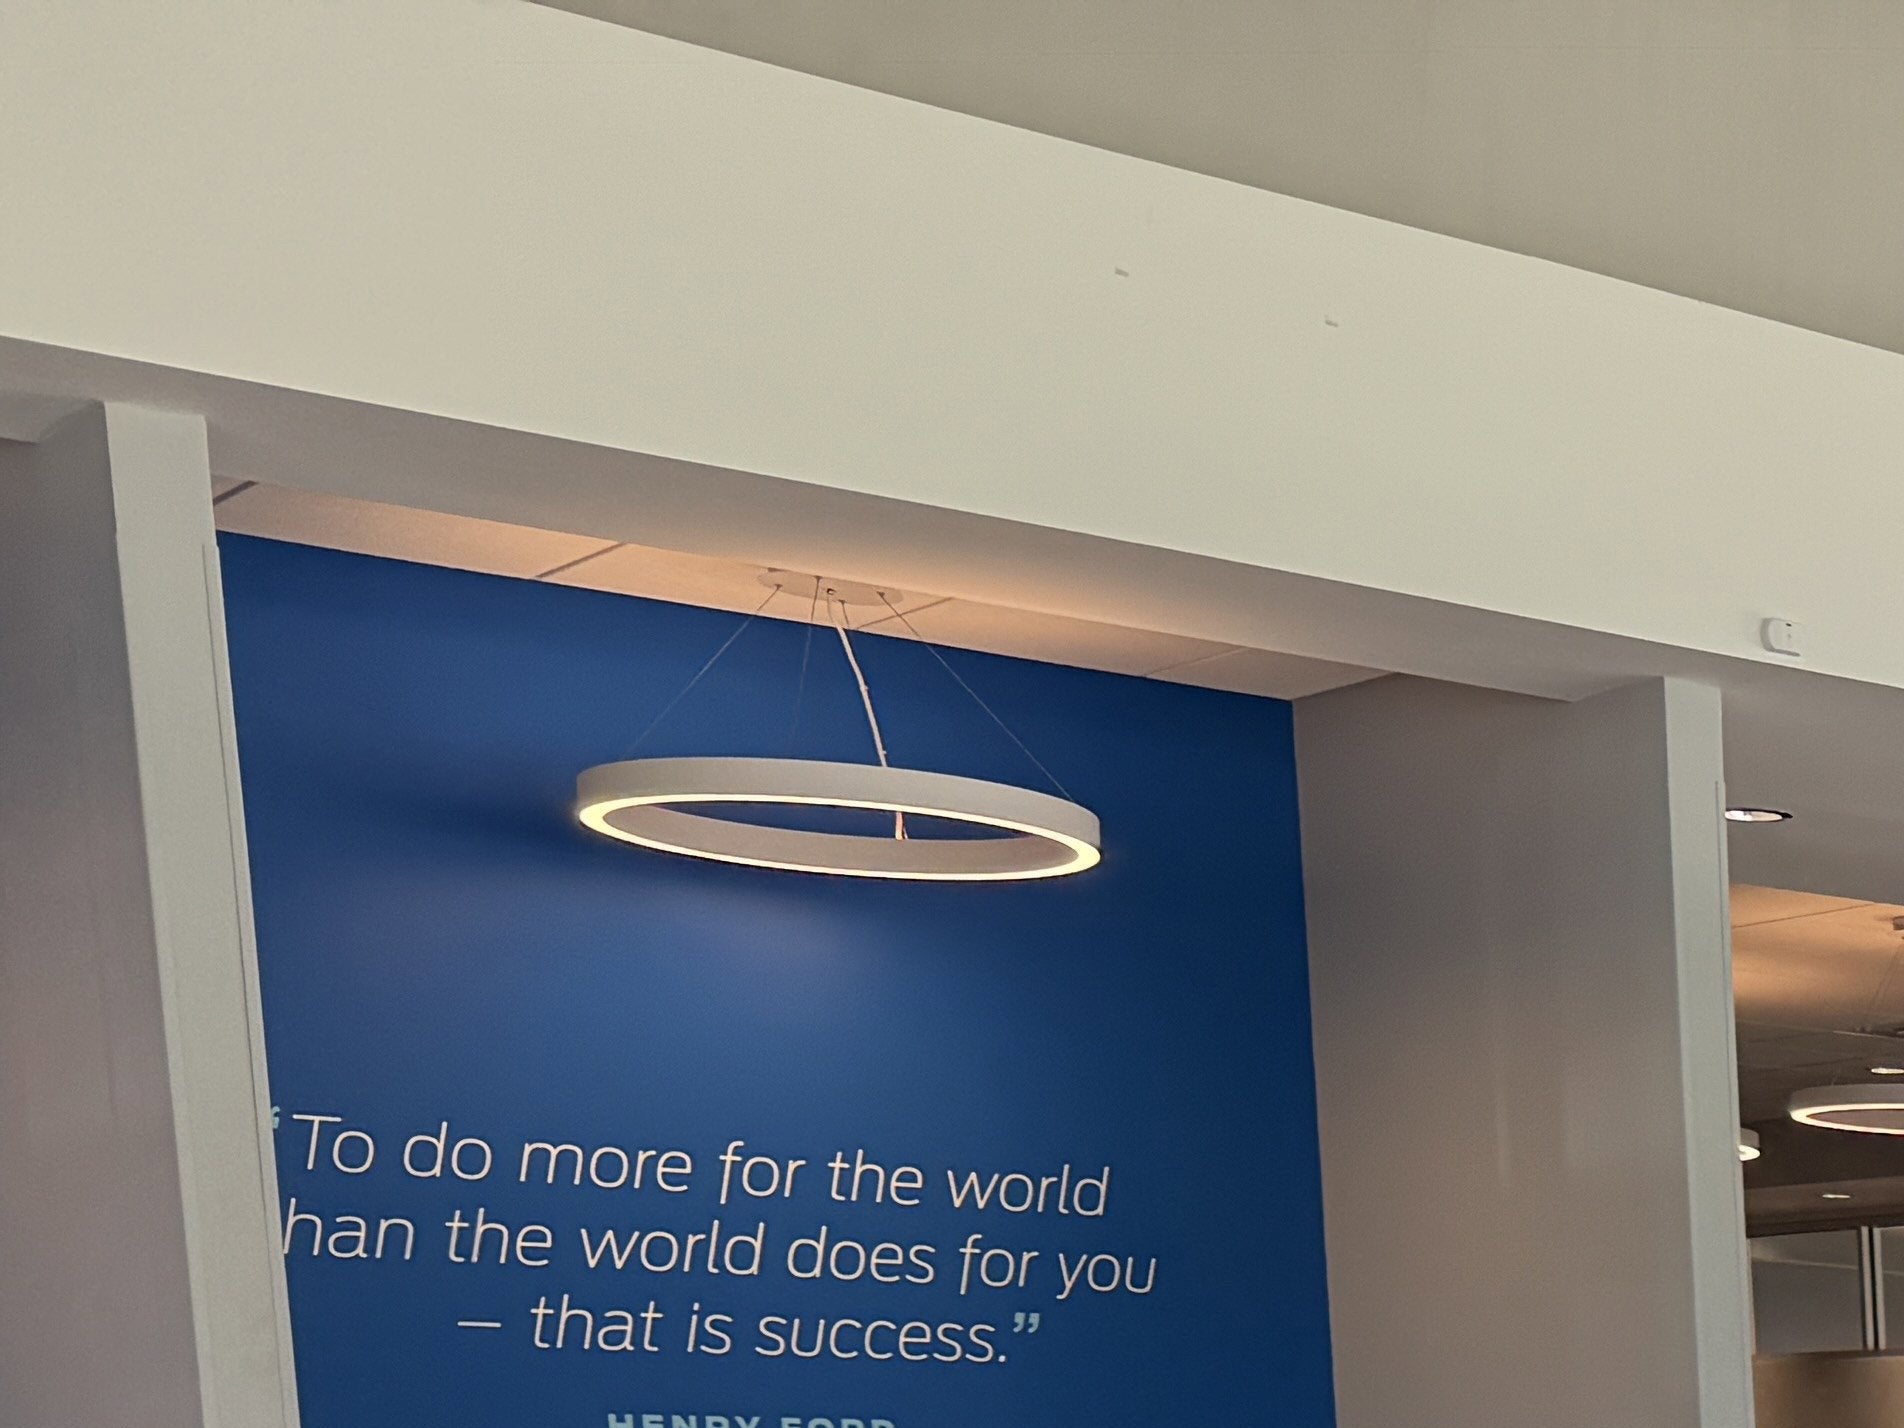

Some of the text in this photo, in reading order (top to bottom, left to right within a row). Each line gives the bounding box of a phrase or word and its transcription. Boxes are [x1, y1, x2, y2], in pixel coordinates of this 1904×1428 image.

[403, 1121, 492, 1180] do
[519, 1142, 692, 1192] more
[718, 1140, 807, 1205] for
[827, 1148, 923, 1206] the
[947, 1164, 1110, 1216] world
[283, 1197, 1157, 1300] han the world does for you
[530, 1293, 664, 1352] that
[687, 1302, 733, 1354] is
